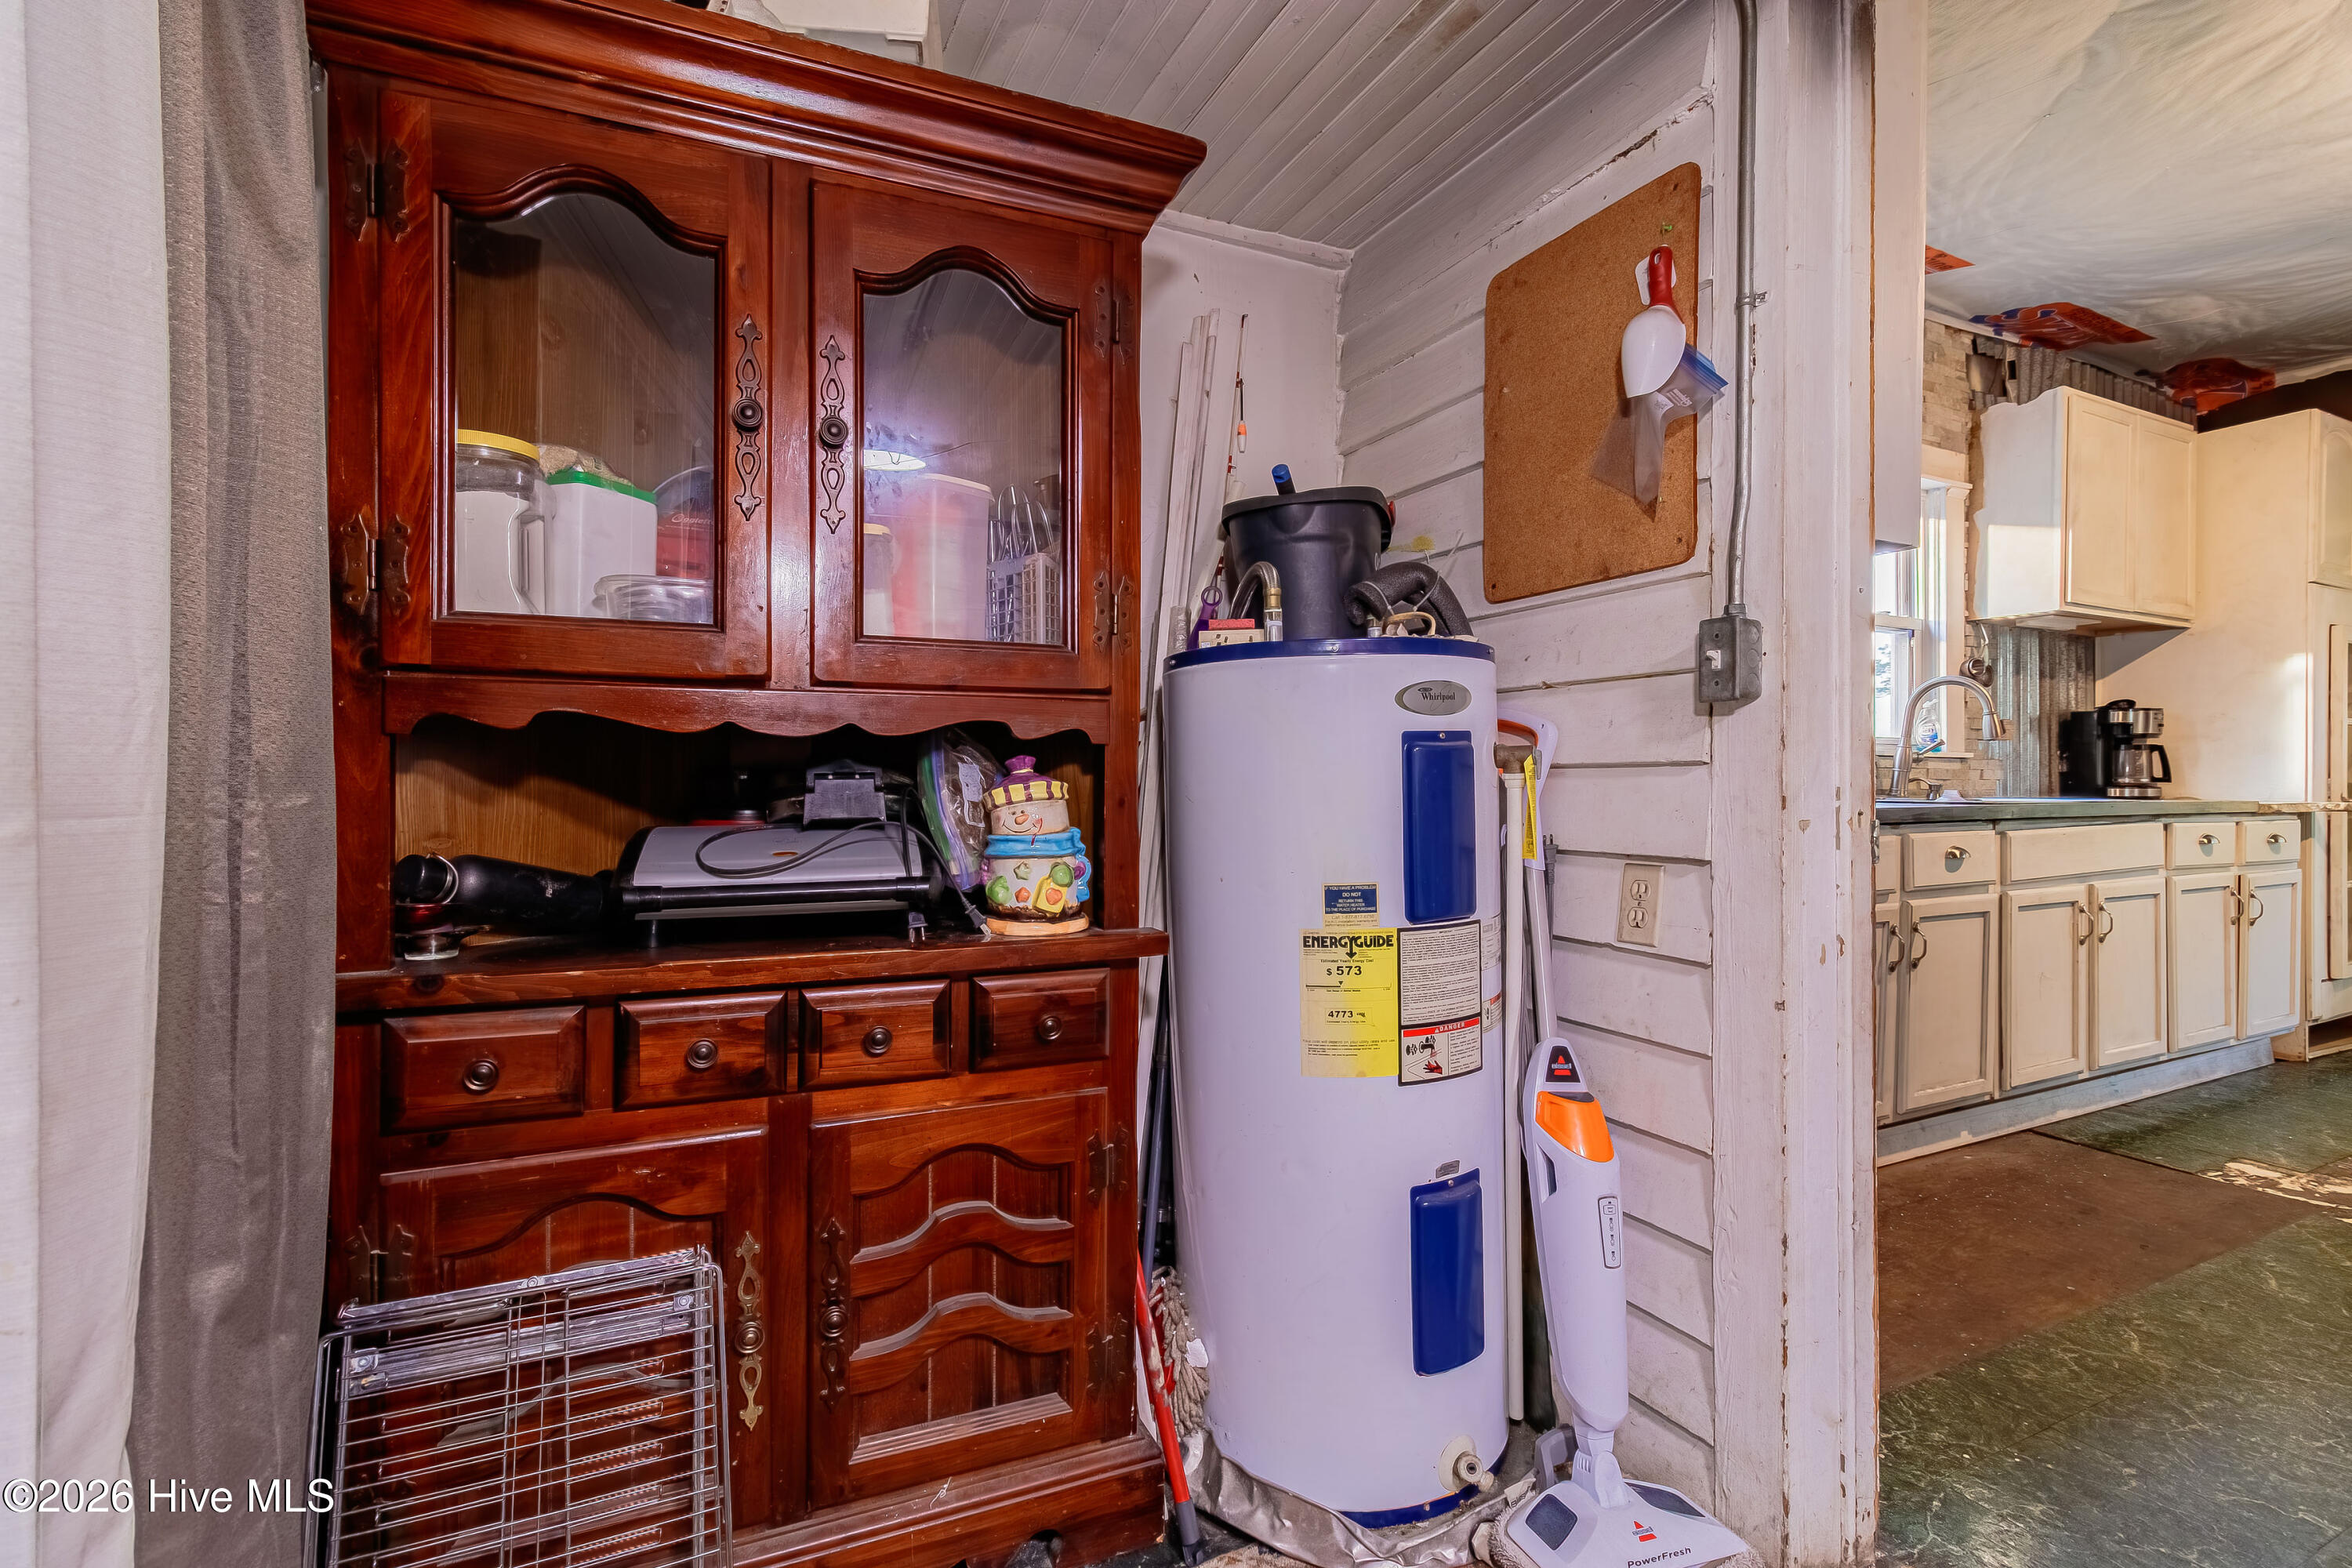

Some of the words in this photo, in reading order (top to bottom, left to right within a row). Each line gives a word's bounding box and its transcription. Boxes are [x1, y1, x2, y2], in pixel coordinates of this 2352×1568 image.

[1421, 692, 1456, 702] Whirlpool
[1302, 935, 1394, 950] ENERGYGUIDE
[1326, 967, 1332, 976] $
[1336, 966, 1362, 975] 573
[1440, 1022, 1465, 1032] DANGER
[1628, 1547, 1691, 1568] PowerFresh
